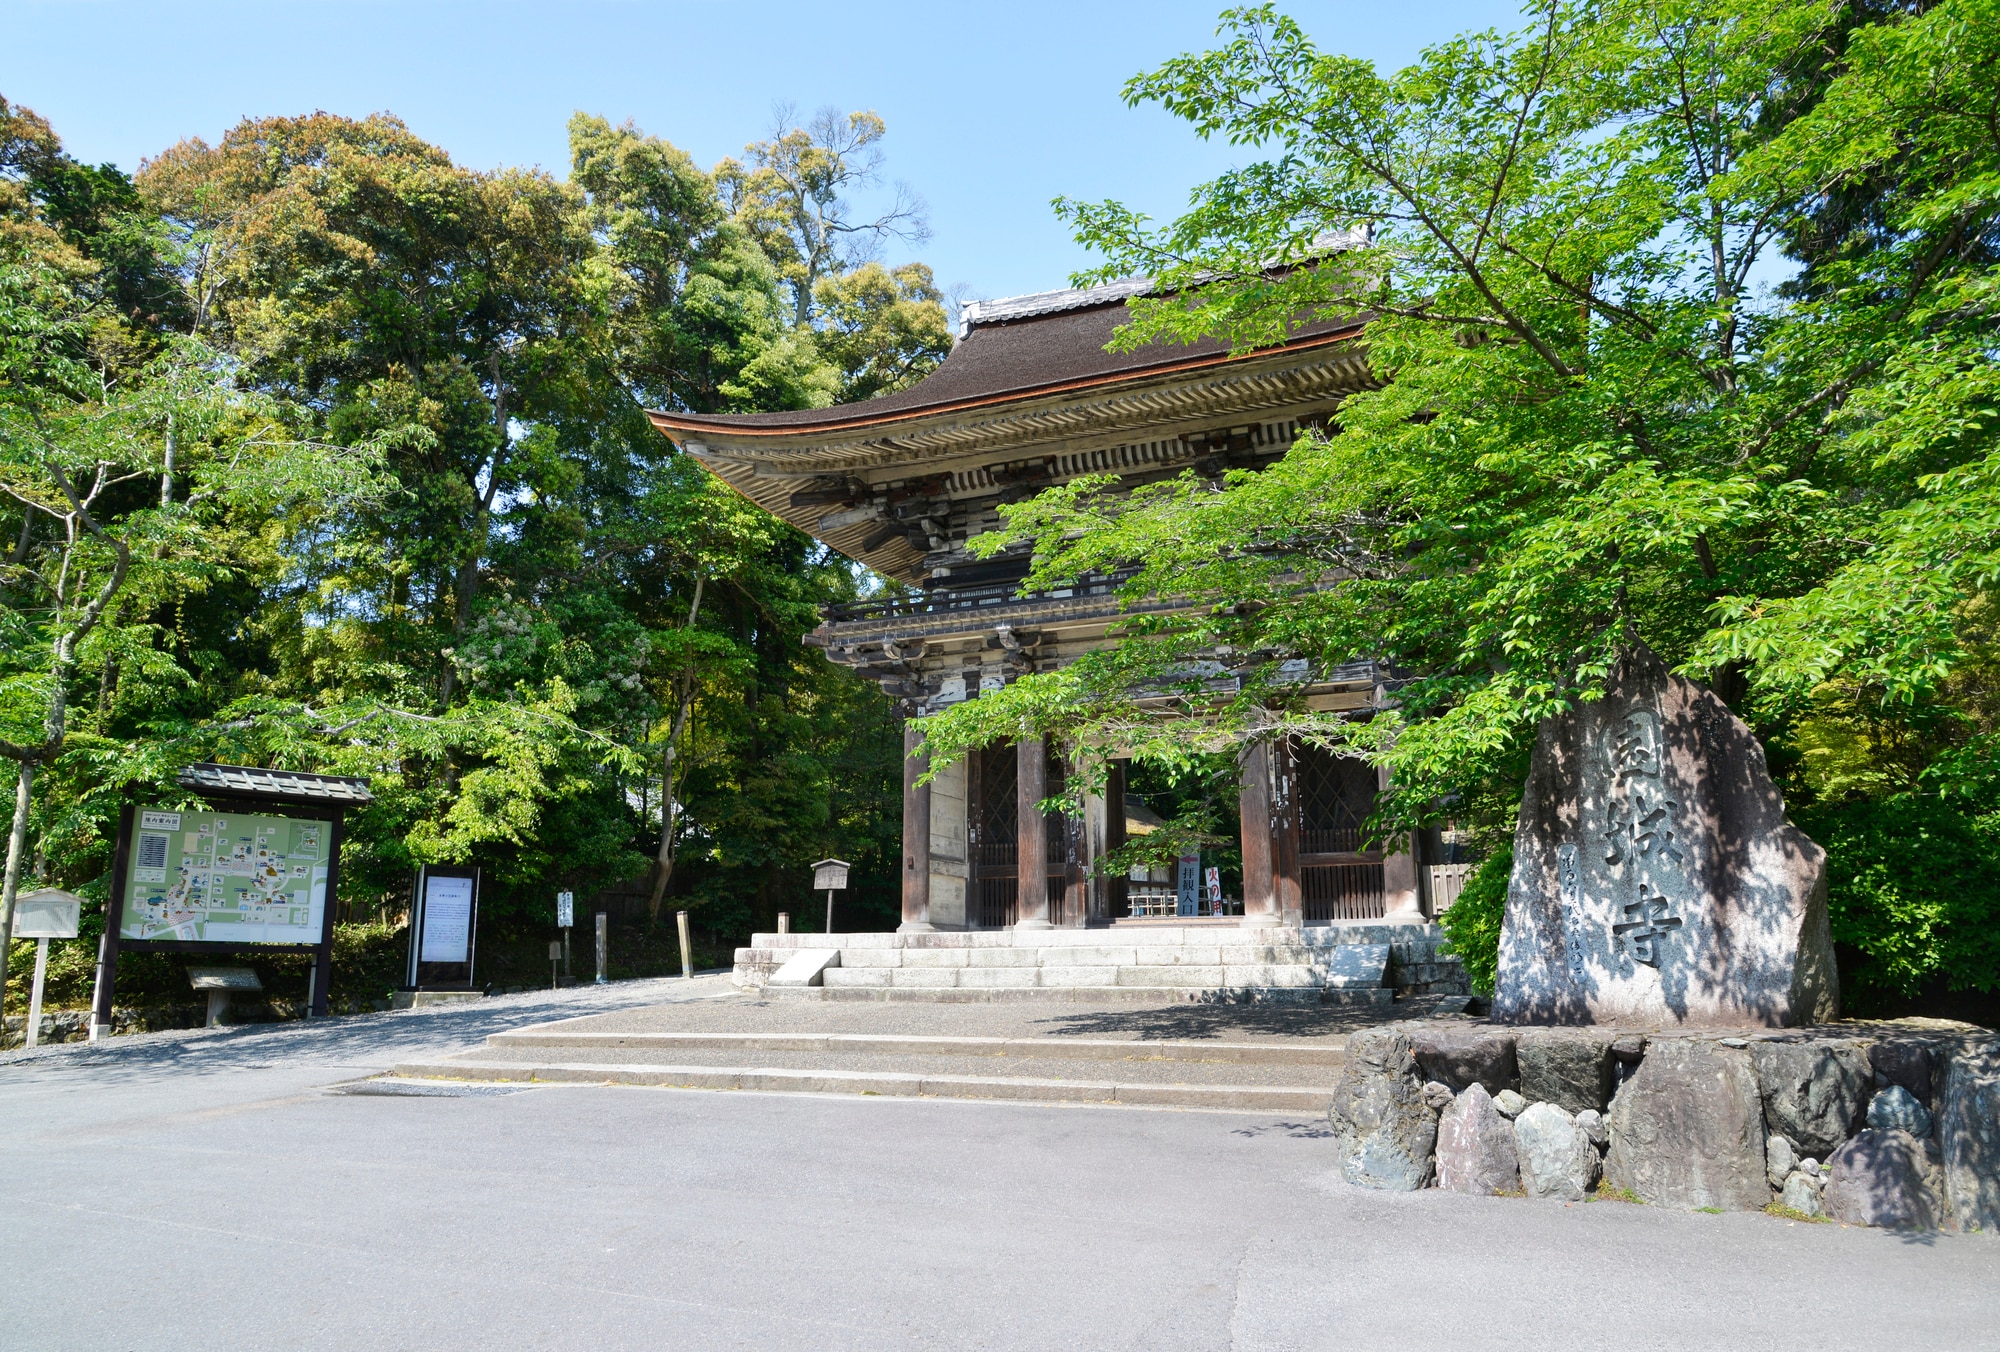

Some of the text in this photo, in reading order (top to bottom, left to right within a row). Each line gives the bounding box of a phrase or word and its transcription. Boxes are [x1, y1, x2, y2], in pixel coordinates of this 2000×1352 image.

[1182, 867, 1195, 915] 拝観入口
[1598, 706, 1684, 969] 園城寺
